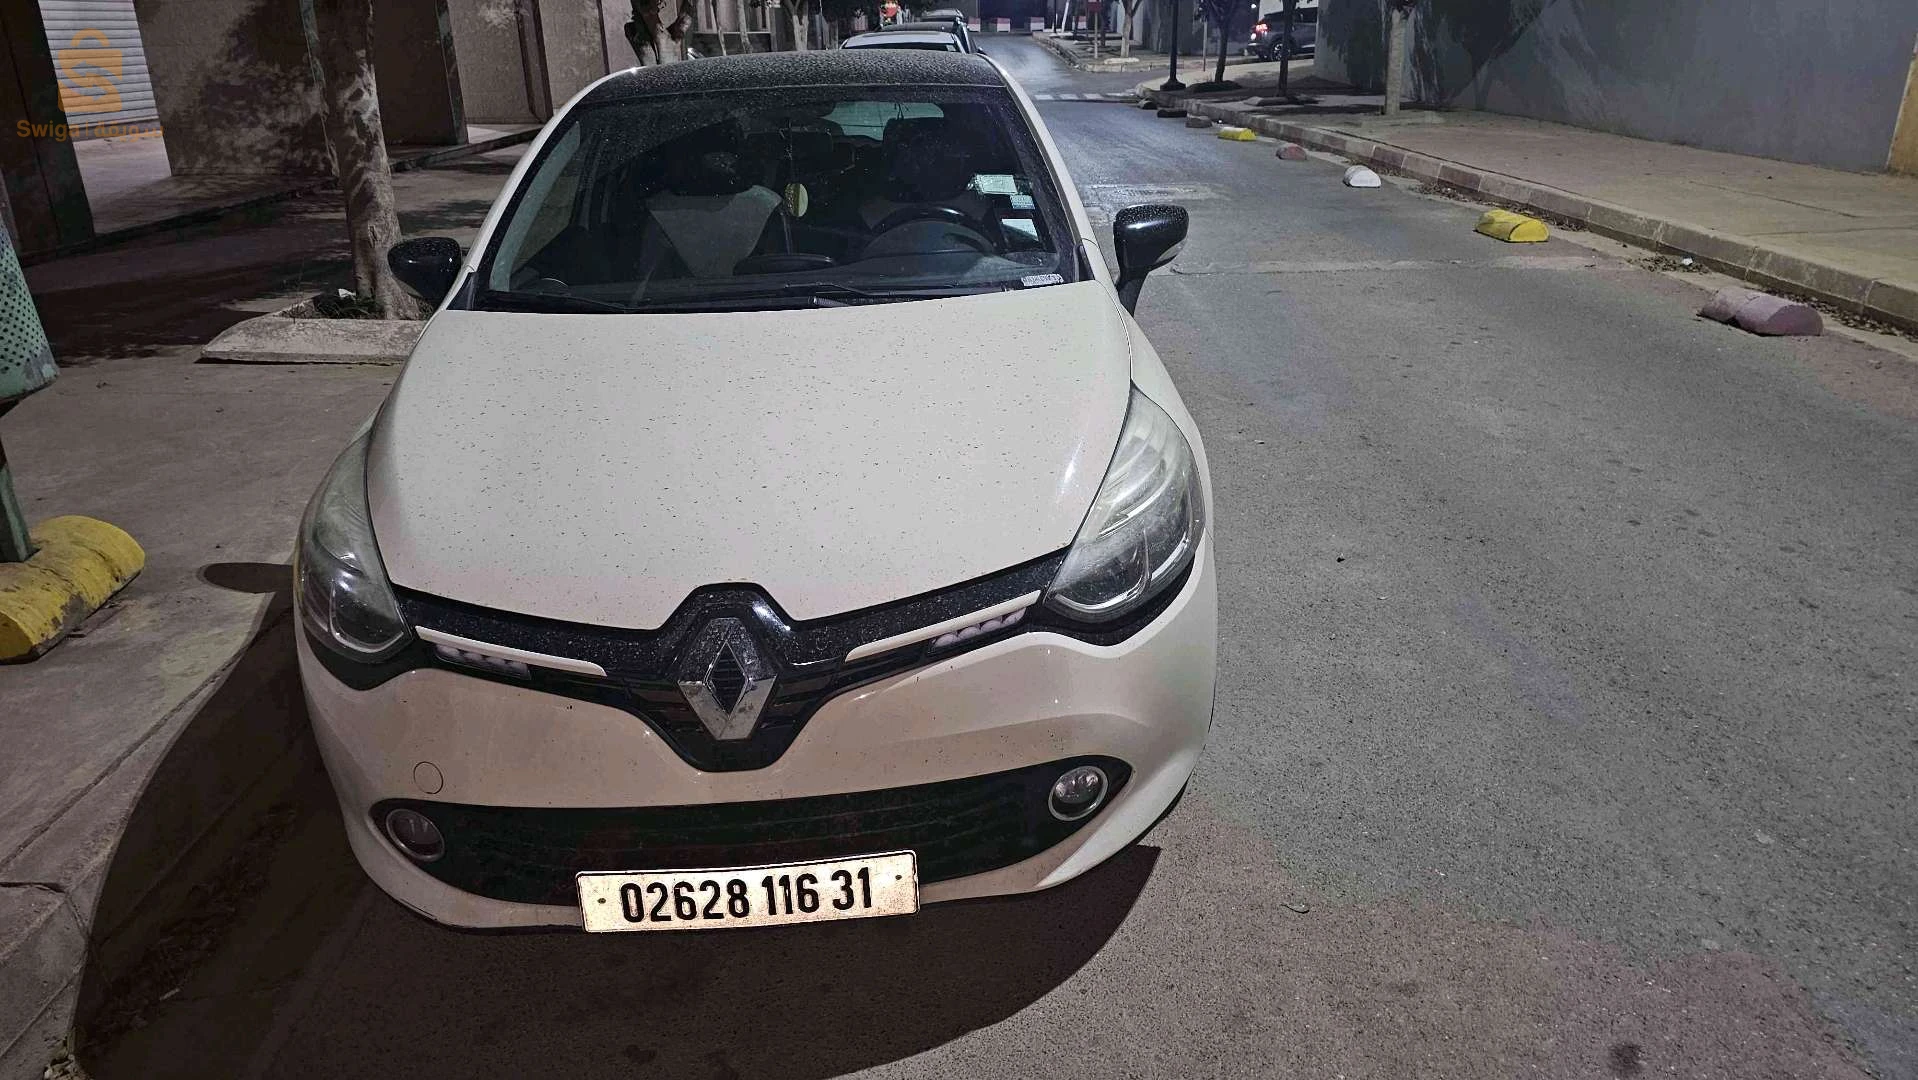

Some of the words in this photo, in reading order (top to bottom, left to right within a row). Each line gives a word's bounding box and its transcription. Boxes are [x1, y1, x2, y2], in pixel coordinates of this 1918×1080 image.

[620, 879, 750, 923] 02628
[761, 872, 820, 915] 116
[831, 866, 873, 911] 31
